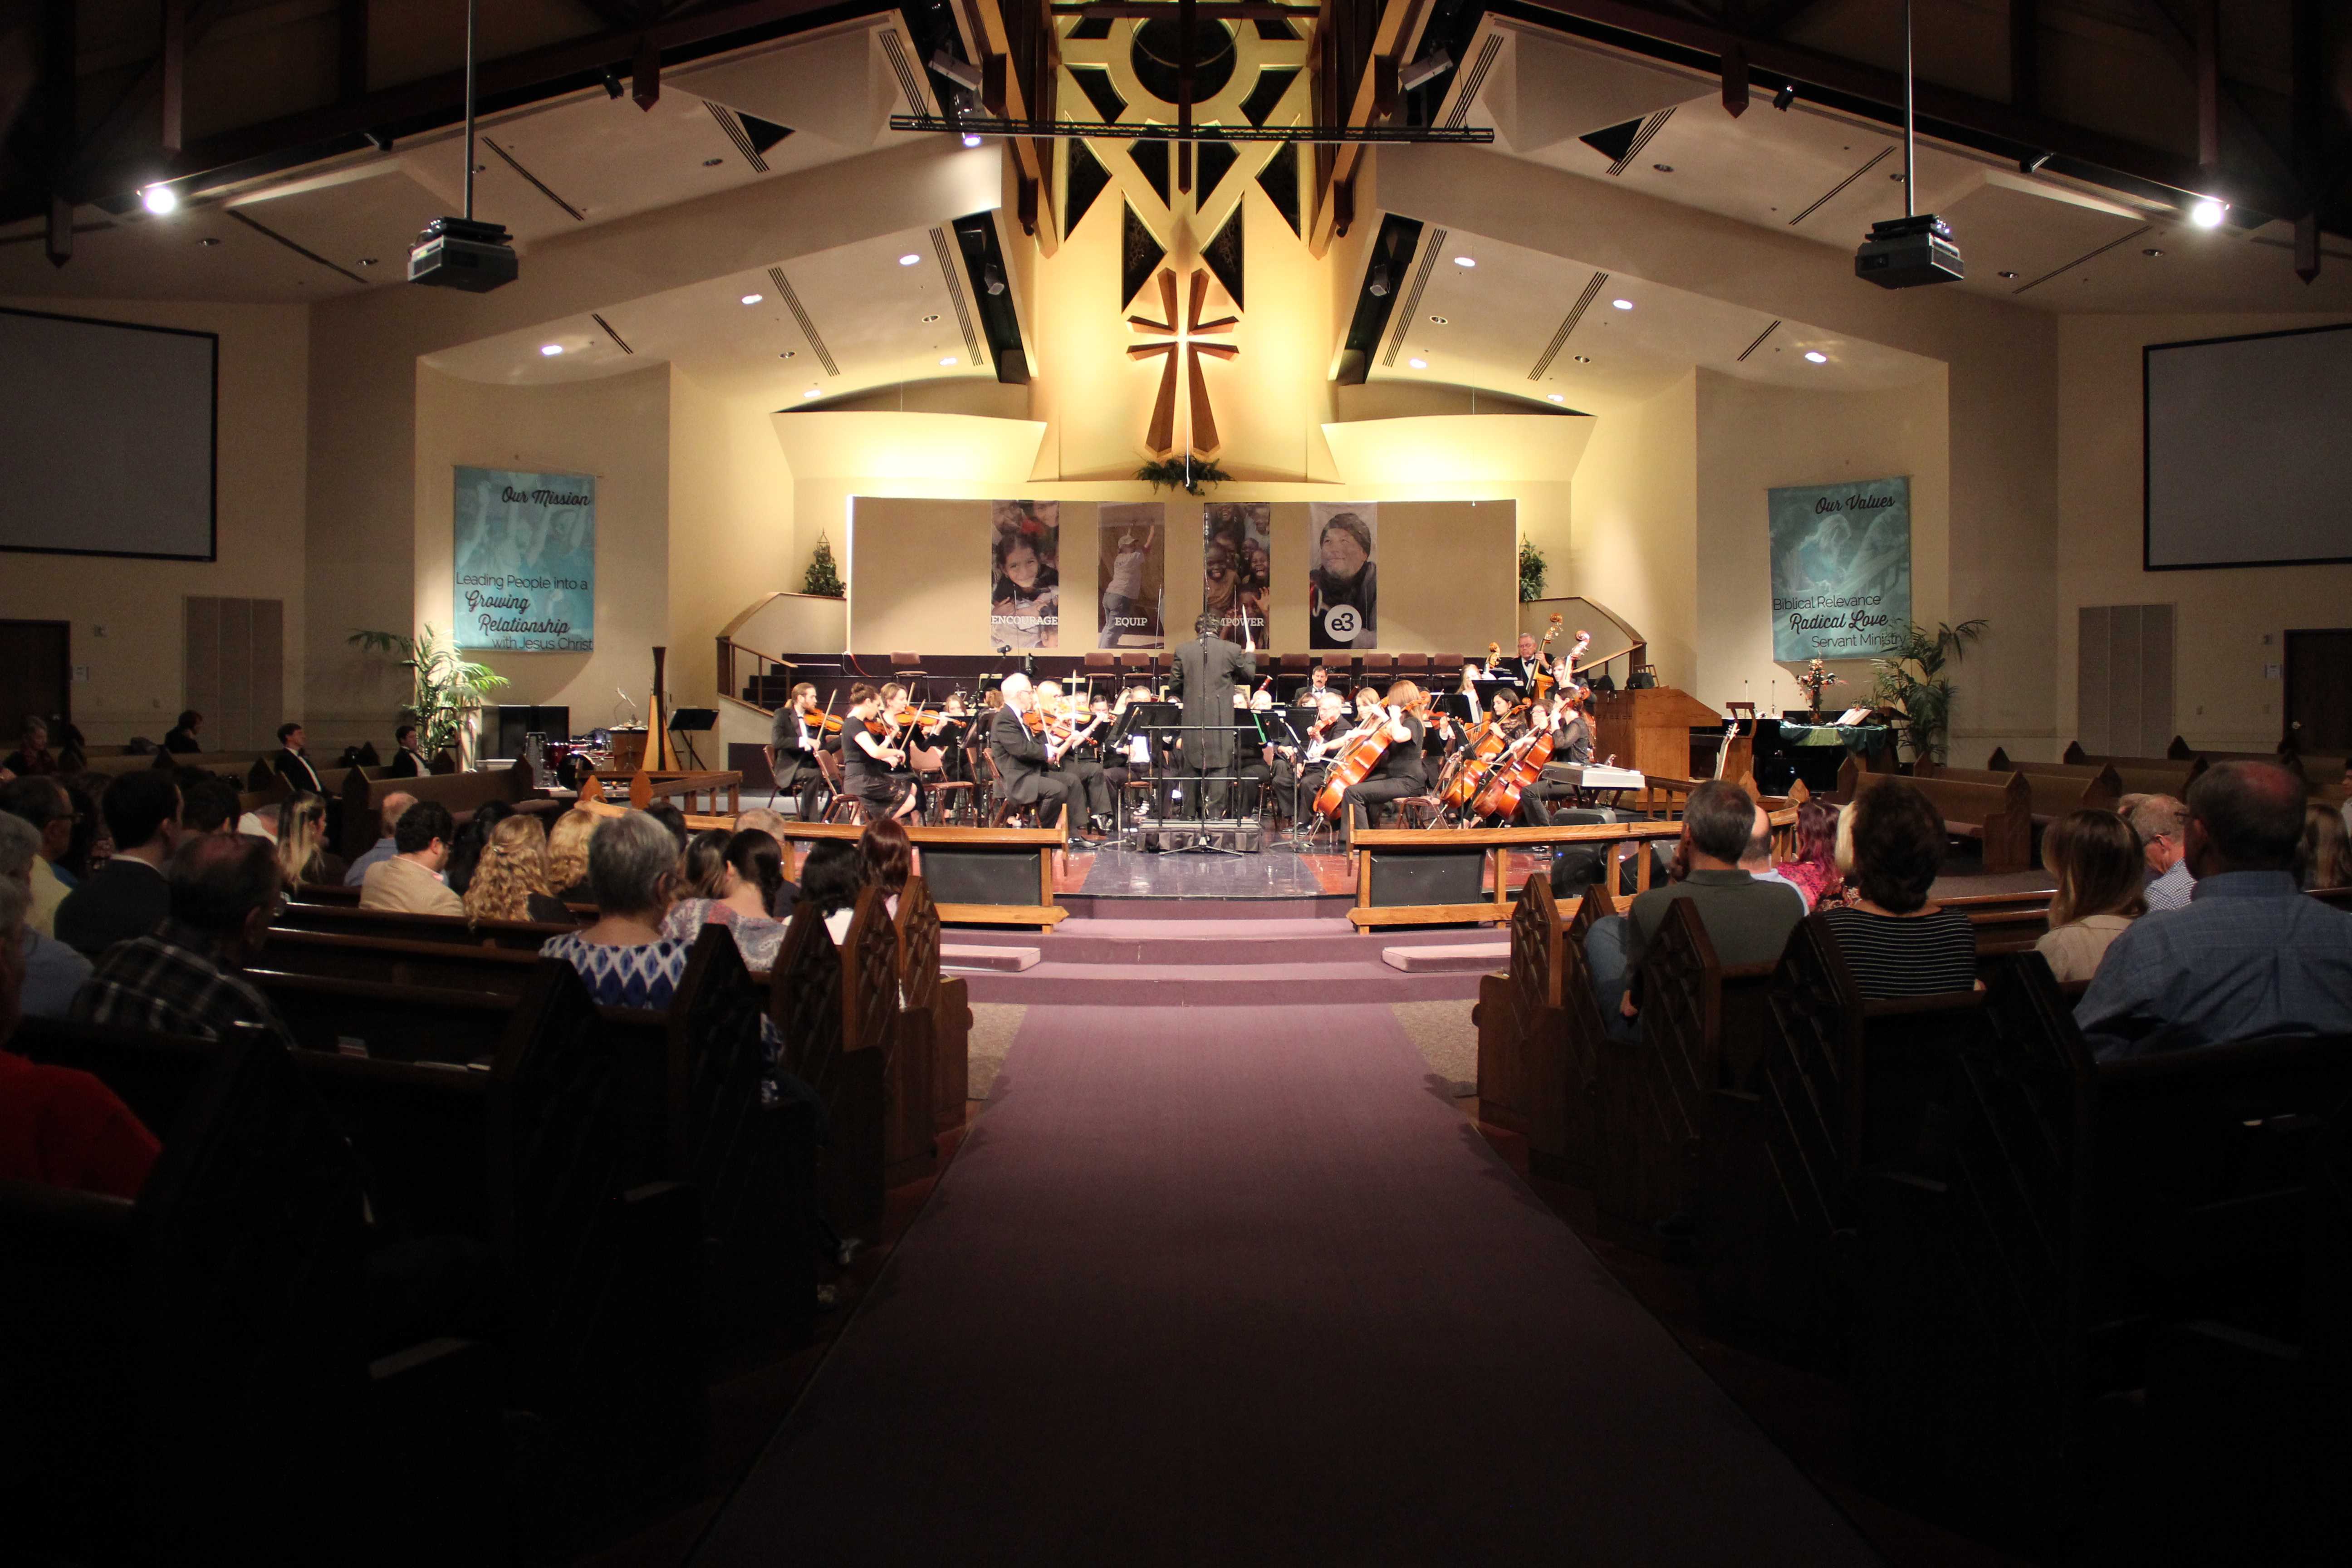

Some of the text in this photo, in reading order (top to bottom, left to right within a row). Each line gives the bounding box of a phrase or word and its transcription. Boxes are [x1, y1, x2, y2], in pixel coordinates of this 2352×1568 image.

[501, 486, 590, 508] Our Mission
[1815, 494, 1895, 514] Our Values
[456, 572, 588, 591] Leading People into a
[465, 589, 530, 614] Growing
[1773, 595, 1882, 610] Biblical Relevance
[478, 613, 570, 636] Relationship
[991, 615, 1058, 625] ENCOURAGE
[1114, 617, 1148, 627] EQUIP
[1220, 617, 1264, 627] MPOWER
[1331, 612, 1354, 632] e3
[1789, 609, 1889, 635] Radical Love
[491, 636, 594, 651] with Jesus Christ
[1811, 633, 1906, 648] Servant Ministry
